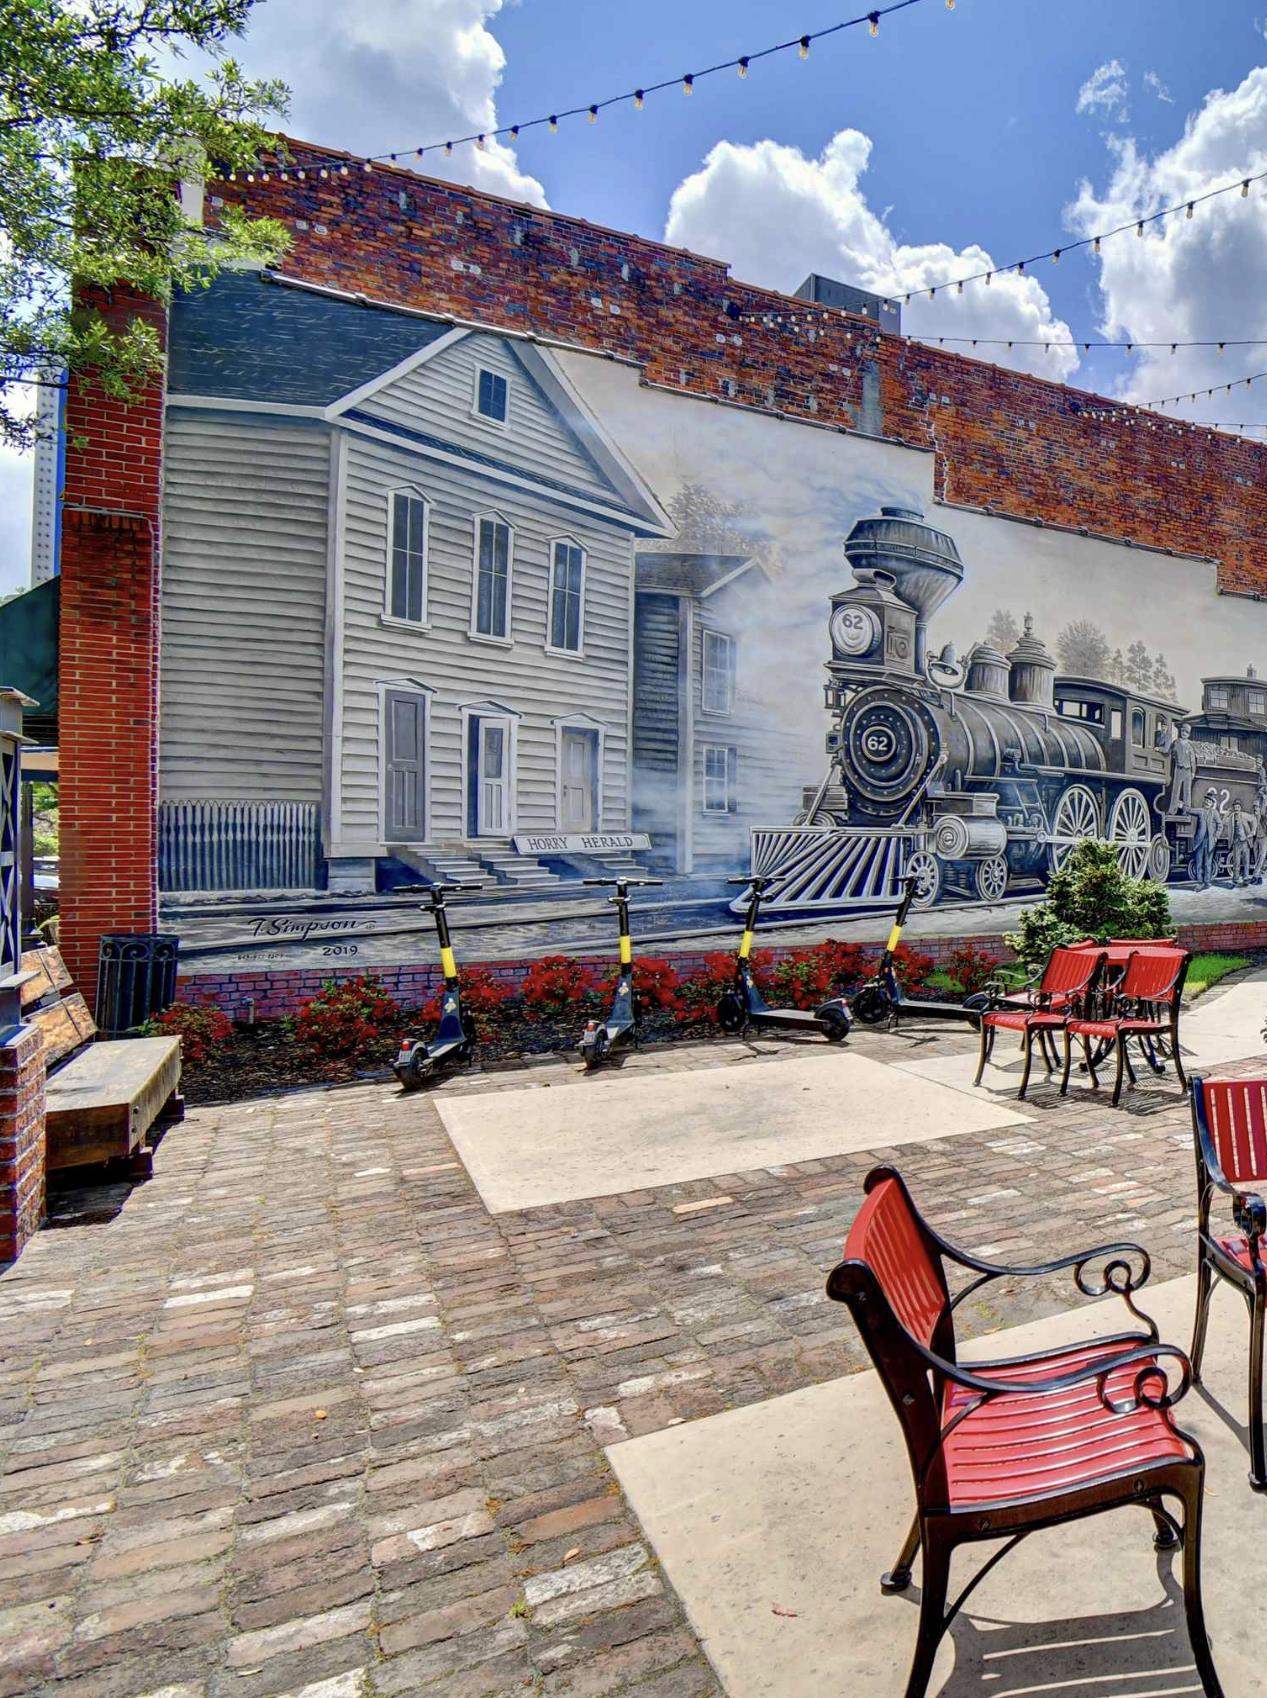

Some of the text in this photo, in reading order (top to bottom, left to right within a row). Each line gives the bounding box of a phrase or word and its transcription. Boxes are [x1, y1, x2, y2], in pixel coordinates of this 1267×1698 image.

[842, 613, 863, 630] 62
[867, 736, 888, 750] 62
[527, 836, 633, 850] HORRY HERALD
[267, 918, 376, 940] Simpson
[322, 946, 358, 956] 2019
